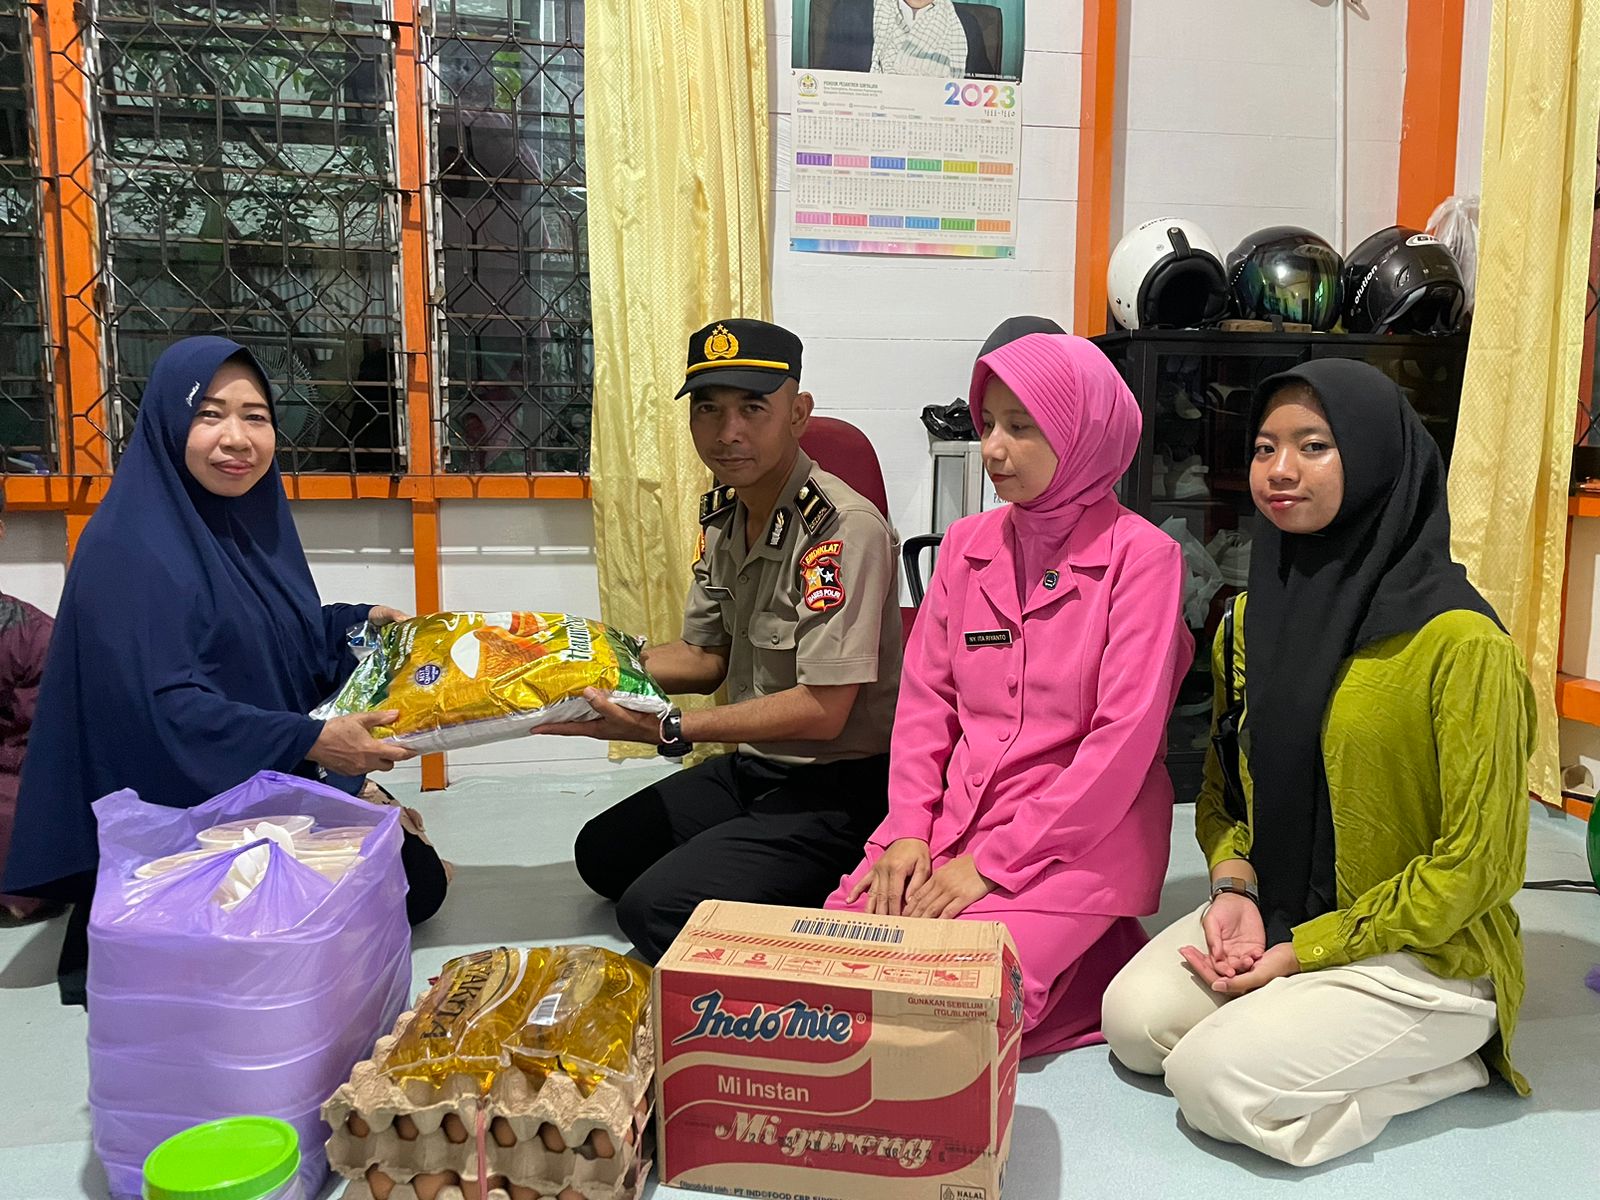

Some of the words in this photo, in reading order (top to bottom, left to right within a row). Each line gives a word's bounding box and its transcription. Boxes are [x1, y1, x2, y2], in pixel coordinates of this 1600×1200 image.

[944, 82, 1015, 109] 2023
[907, 997, 945, 1007] GUNAKAN
[946, 1000, 983, 1010] SEBELUM
[718, 1074, 741, 1095] Mi
[746, 1078, 809, 1102] Instan
[715, 1111, 781, 1145] Mi
[781, 1126, 933, 1170] goreng
[734, 1188, 744, 1196] PT
[746, 1189, 792, 1200] INDOFOOD
[957, 1190, 984, 1200] HALAL
